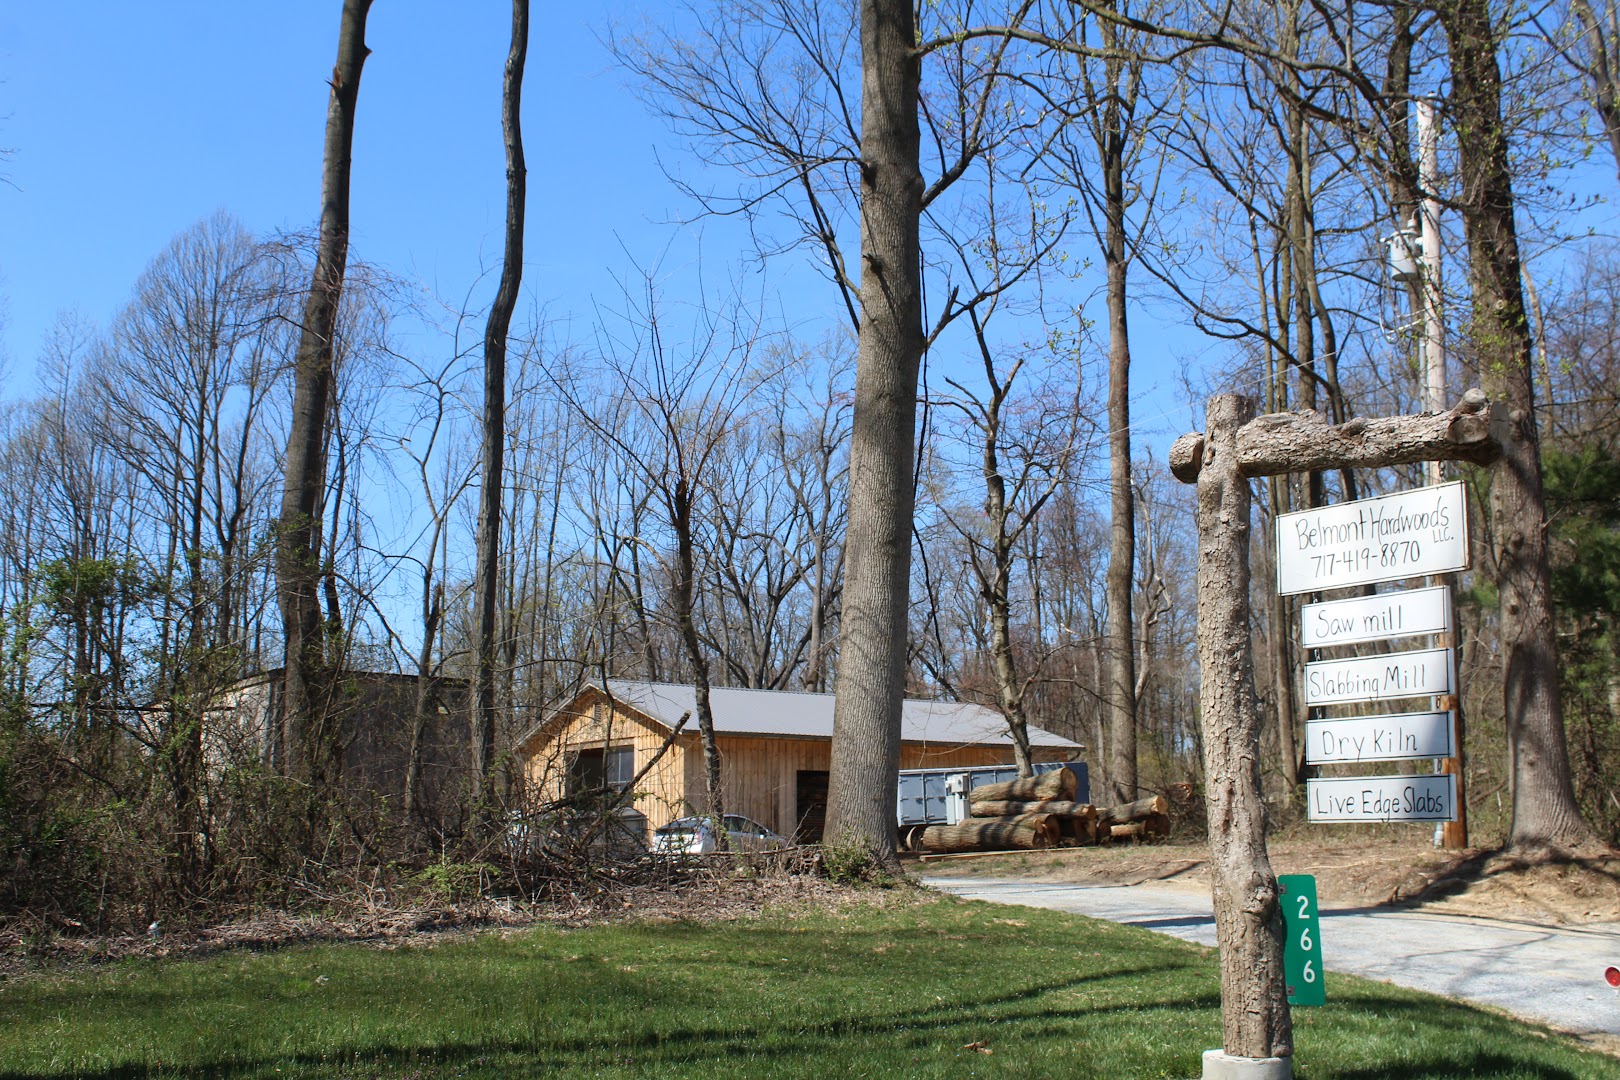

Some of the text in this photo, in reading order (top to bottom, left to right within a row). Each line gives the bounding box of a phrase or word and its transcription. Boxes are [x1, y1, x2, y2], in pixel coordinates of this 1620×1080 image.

[1296, 496, 1449, 550] Belmont Hardwoods
[1311, 540, 1420, 578] 717-419-8870
[1316, 605, 1401, 638] Saw mill
[1310, 664, 1425, 701] Slabbing Mill
[1322, 727, 1417, 762] Dry Kiln
[1316, 786, 1443, 823] Live Edge Slabs
[1296, 895, 1316, 983] 266
